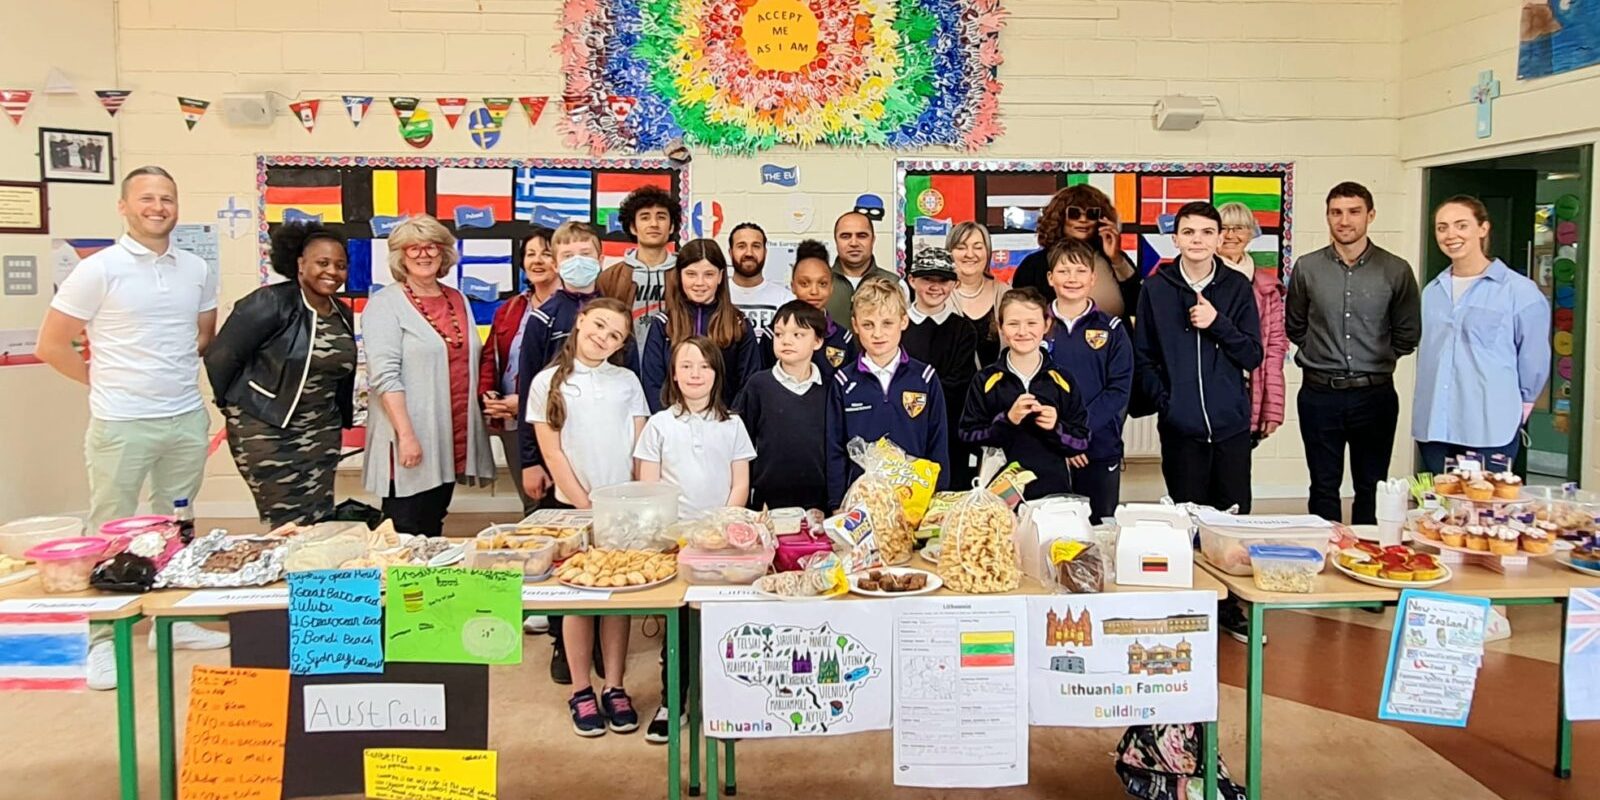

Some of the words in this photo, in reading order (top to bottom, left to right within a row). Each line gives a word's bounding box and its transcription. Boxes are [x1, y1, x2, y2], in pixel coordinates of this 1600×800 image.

[758, 11, 803, 23] ACCEPT
[772, 26, 788, 36] ME
[757, 43, 771, 55] AS
[778, 43, 782, 52] I
[790, 42, 808, 53] AM
[764, 173, 781, 181] THE
[783, 171, 796, 180] EU
[465, 211, 484, 220] Poland
[922, 224, 944, 232] Portugal
[470, 283, 490, 292] Finland
[1408, 600, 1431, 613] New
[1428, 615, 1469, 630] Zealand
[841, 655, 863, 666] UTENA
[819, 685, 849, 698] VILNIUS
[1060, 682, 1133, 696] Lithuanian
[1136, 681, 1189, 694] Famous
[309, 697, 440, 729] Australia
[805, 711, 828, 723] ALYTUS
[1094, 705, 1156, 719] Buildings
[709, 719, 773, 732] Lithuania
